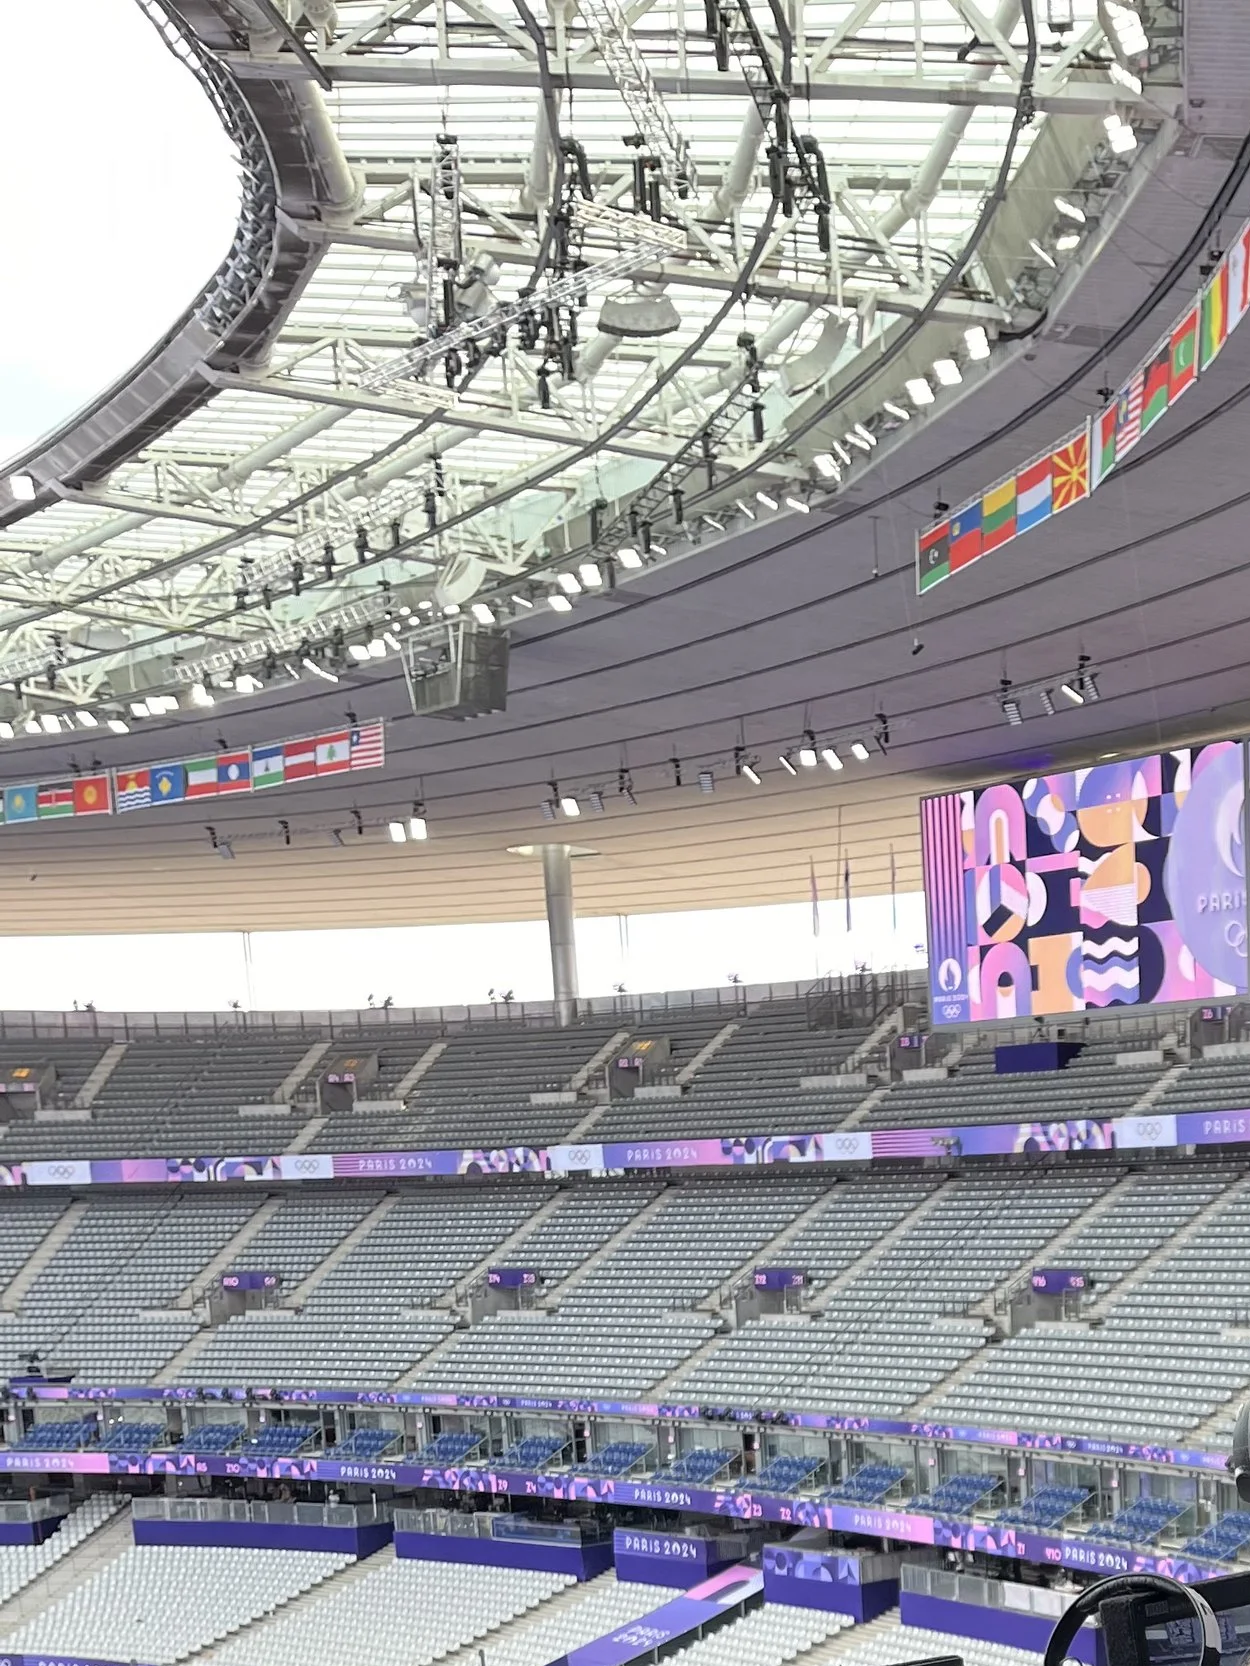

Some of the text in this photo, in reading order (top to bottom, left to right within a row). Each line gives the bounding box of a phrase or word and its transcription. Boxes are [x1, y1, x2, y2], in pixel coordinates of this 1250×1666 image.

[1203, 1117, 1246, 1134] PARIS
[626, 1146, 697, 1161] PARIS 2024
[359, 1157, 432, 1171] PARIS 2024
[6, 1457, 75, 1468] PARIS 2024
[340, 1465, 396, 1480] PARIS 2024
[634, 1488, 691, 1506] PARIS 2024
[854, 1514, 912, 1533] PARIS 2024
[625, 1536, 697, 1558] PARIS 2024
[1065, 1547, 1128, 1570] PARIS 2024
